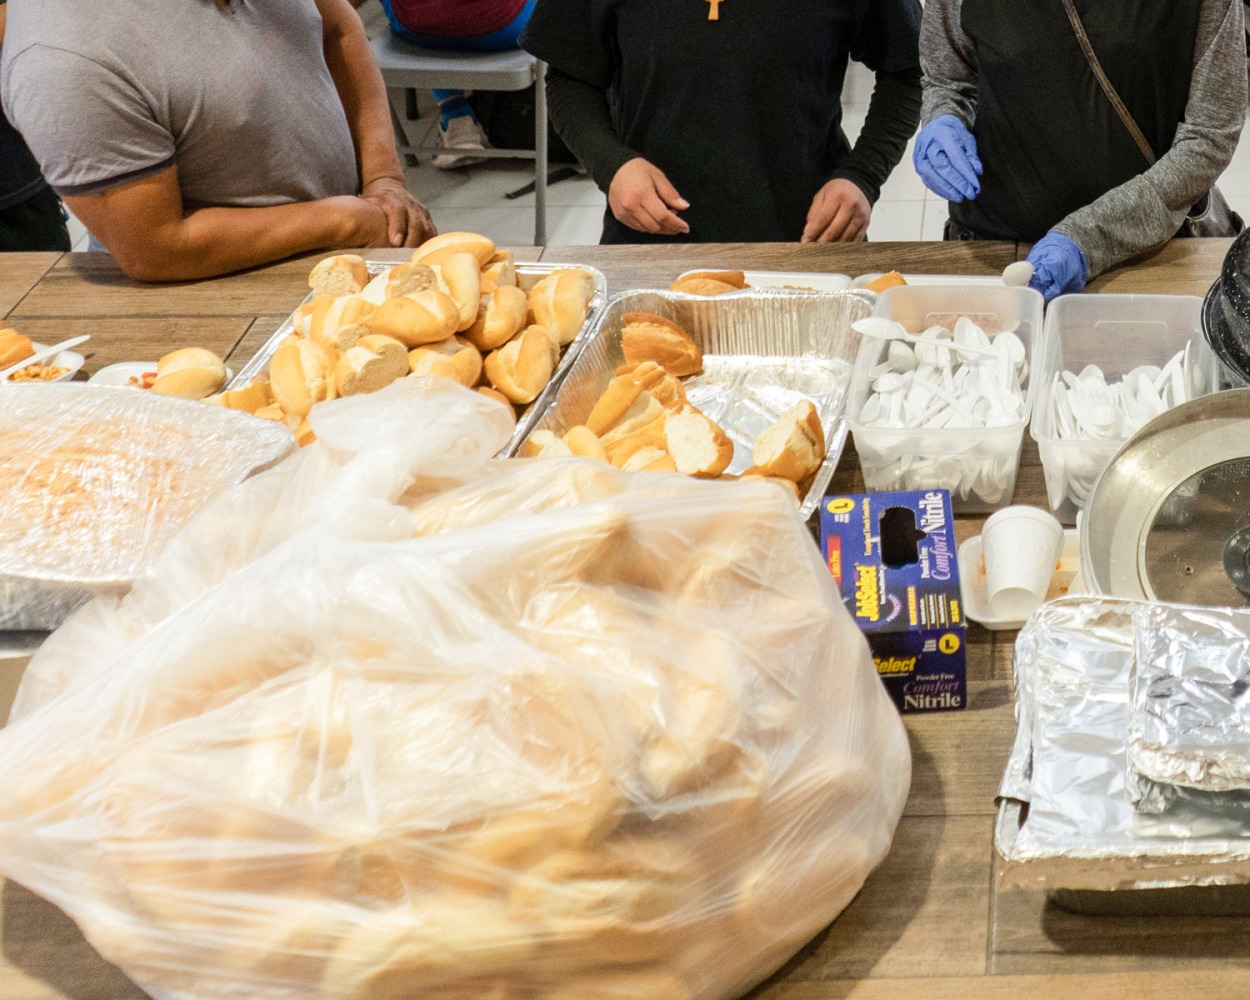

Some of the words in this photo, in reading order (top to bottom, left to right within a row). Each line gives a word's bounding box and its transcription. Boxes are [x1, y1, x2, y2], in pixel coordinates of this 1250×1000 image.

[918, 492, 947, 535] Nitrile
[919, 547, 929, 561] Free
[929, 535, 953, 581] Comfort
[919, 561, 931, 579] Powder
[855, 565, 879, 622] JobSelect
[944, 639, 953, 650] L
[916, 674, 939, 682] Powder
[903, 681, 960, 694] Comfort
[904, 692, 960, 710] Nitrile
